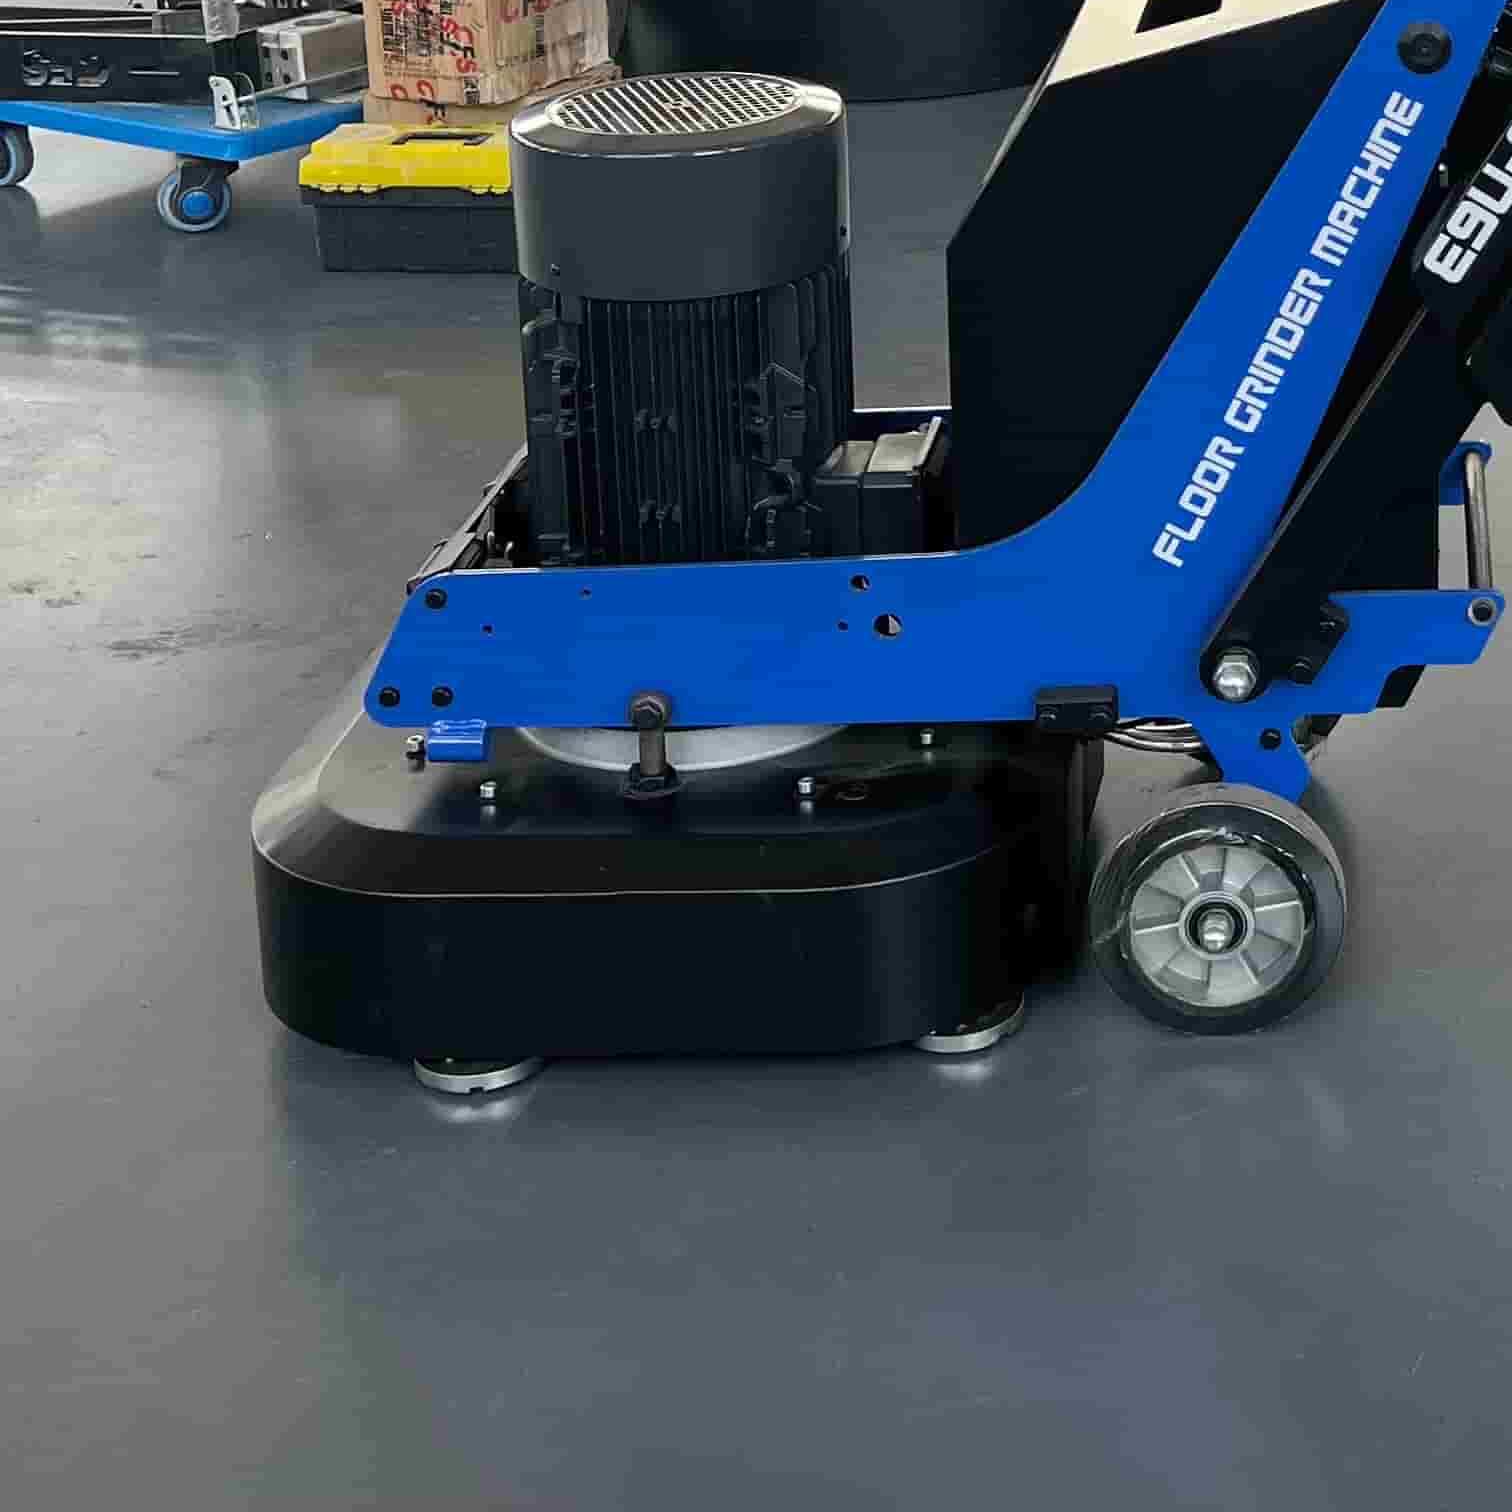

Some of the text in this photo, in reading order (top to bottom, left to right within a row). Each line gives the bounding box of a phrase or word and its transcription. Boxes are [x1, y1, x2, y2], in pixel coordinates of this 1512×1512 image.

[1152, 90, 1424, 568] FLOOR GRINDER MACHINE
